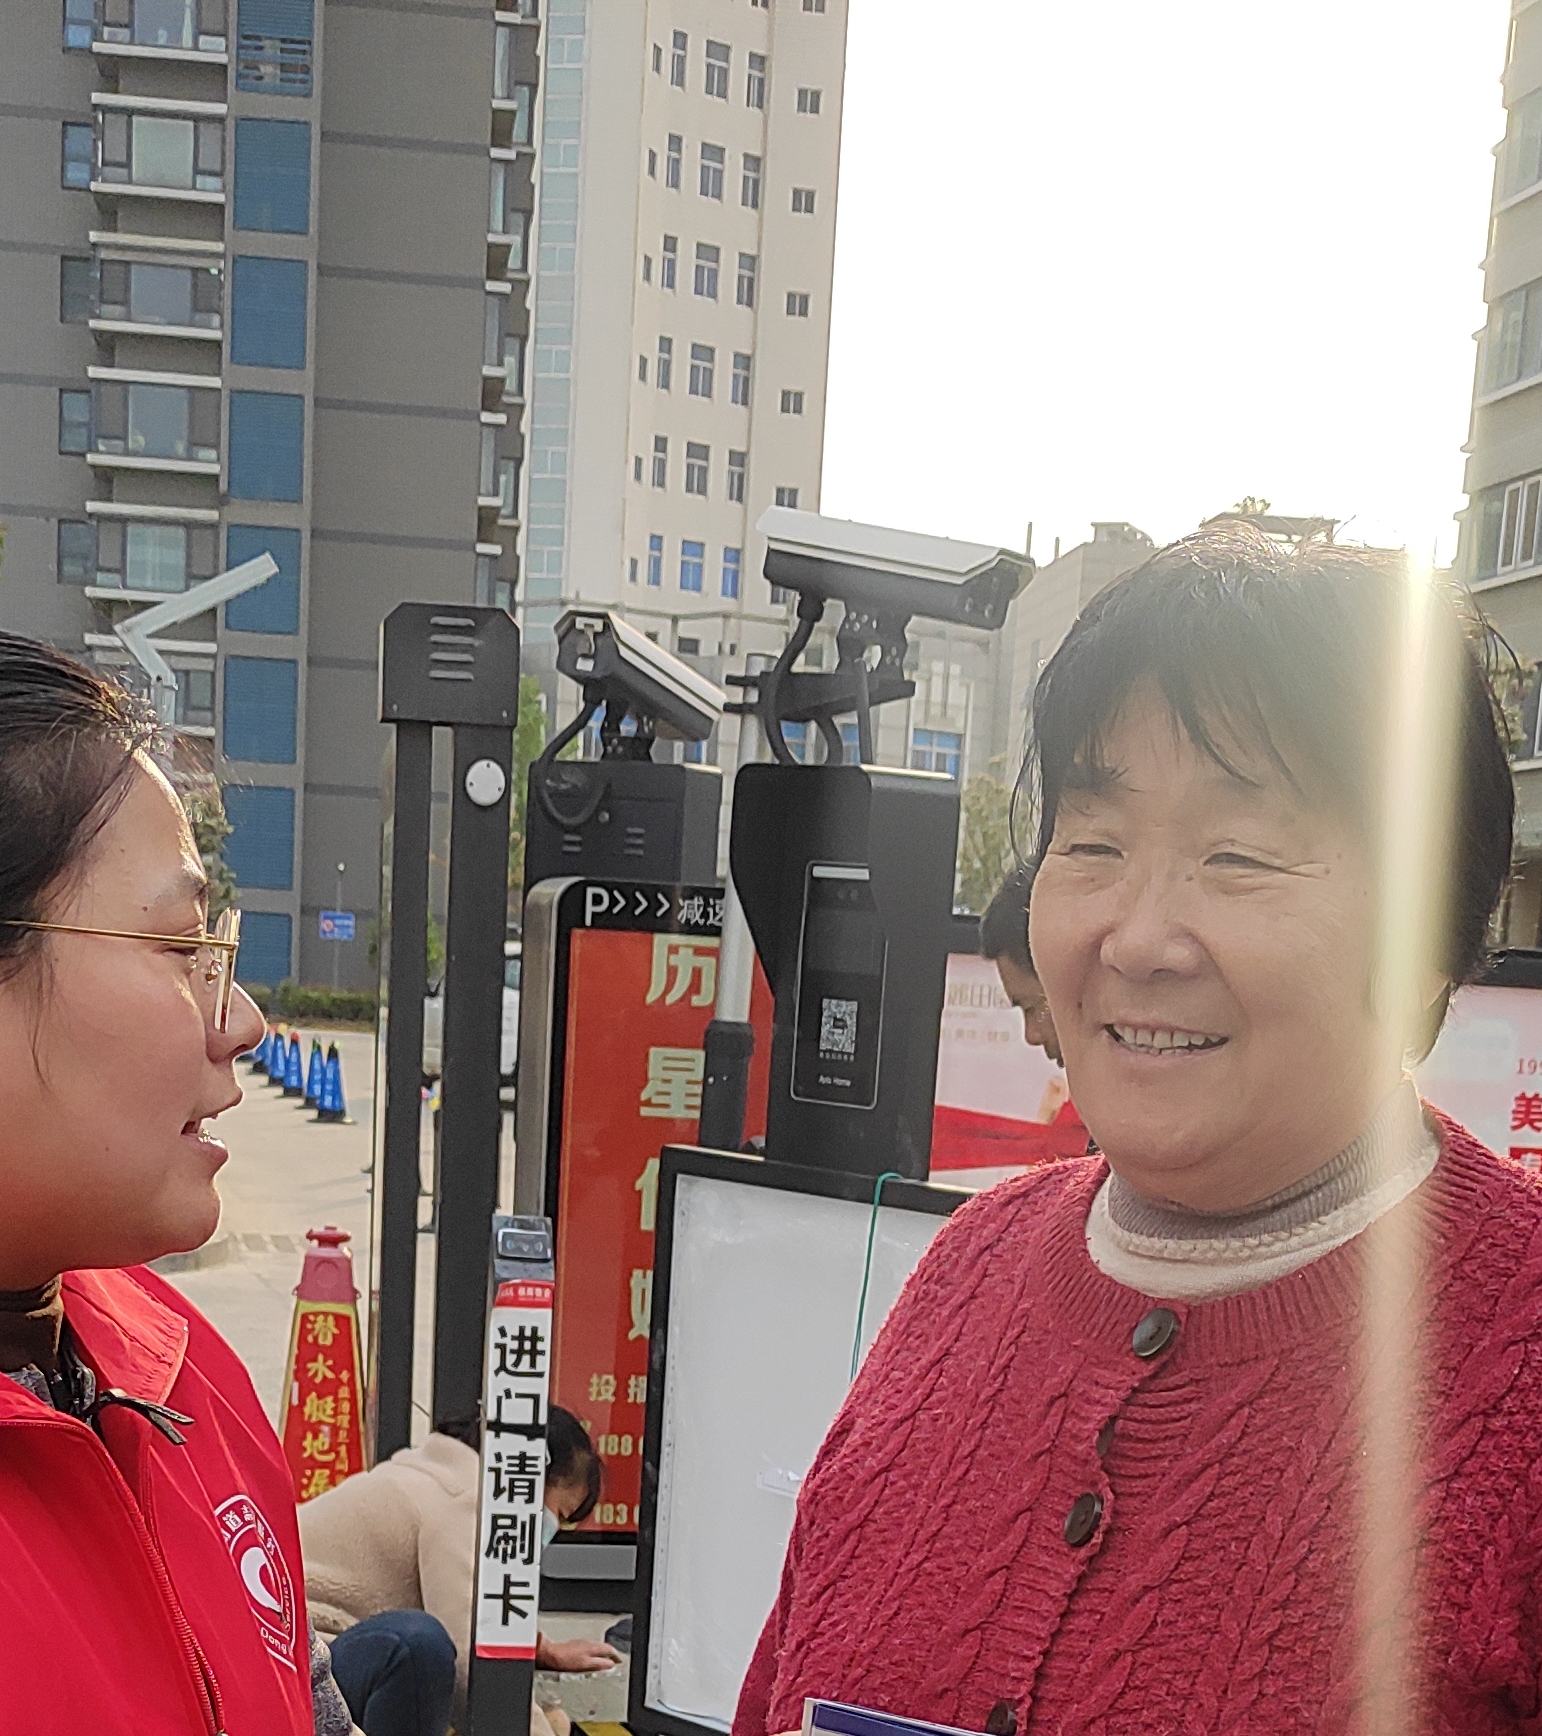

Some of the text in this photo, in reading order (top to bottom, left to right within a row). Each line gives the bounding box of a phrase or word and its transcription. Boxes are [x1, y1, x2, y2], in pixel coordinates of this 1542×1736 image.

[483, 1326, 546, 1626] 进门请刷卡
